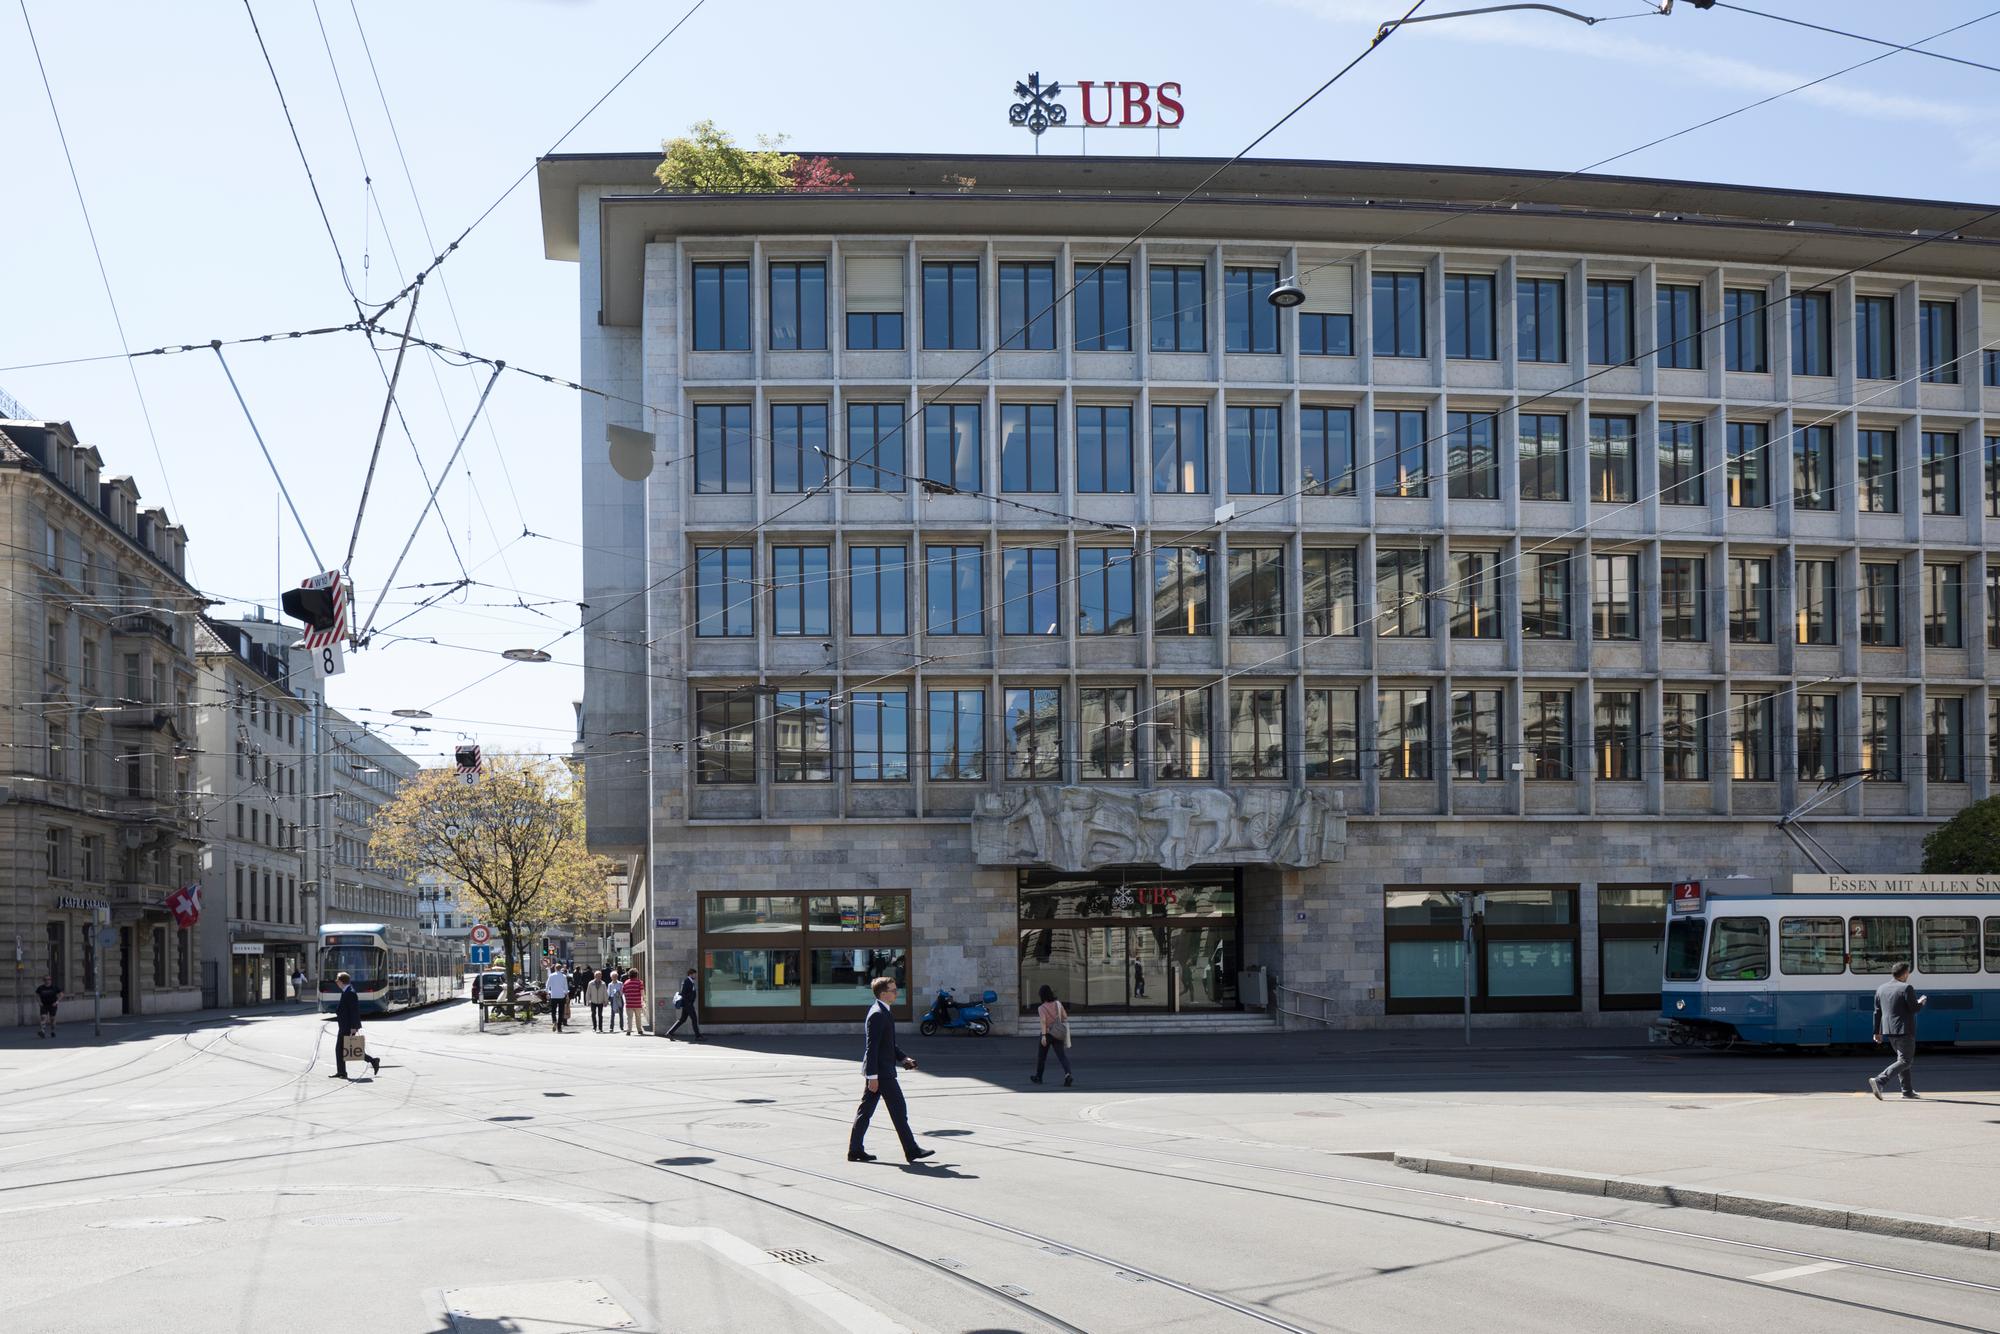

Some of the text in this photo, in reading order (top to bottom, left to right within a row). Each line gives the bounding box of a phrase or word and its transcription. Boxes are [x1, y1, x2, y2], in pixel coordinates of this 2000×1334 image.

[1078, 81, 1184, 127] UBS
[323, 648, 334, 674] 8
[466, 773, 474, 784] 8
[1684, 883, 1692, 898] 2
[1829, 876, 1877, 891] ESSEN
[1885, 880, 1913, 891] MIT
[1920, 880, 1969, 892] ALLEN
[1137, 887, 1178, 905] UBS
[477, 930, 485, 938] 30
[1855, 926, 1862, 936] 2
